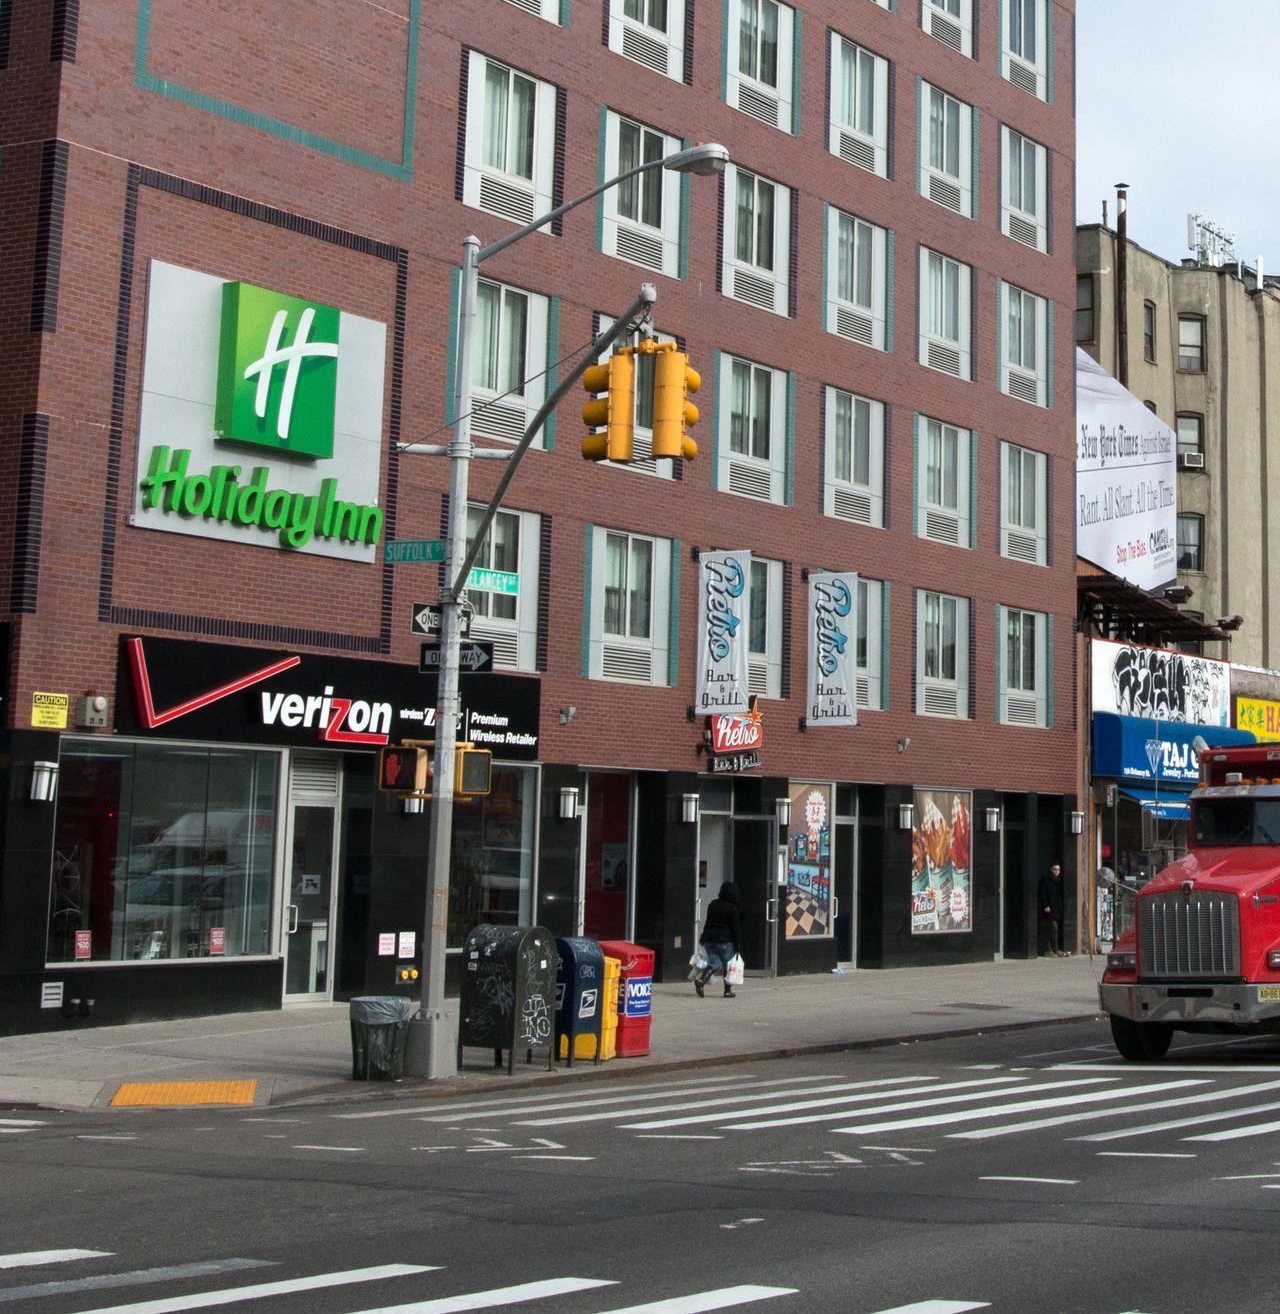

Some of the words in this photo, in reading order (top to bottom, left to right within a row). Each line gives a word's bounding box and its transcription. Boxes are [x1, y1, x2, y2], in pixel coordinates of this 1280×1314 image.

[1081, 424, 1098, 459] New
[1099, 424, 1117, 467] York
[1118, 424, 1138, 458] Times
[140, 444, 320, 548] Holiday
[315, 477, 383, 545] Inn
[1102, 486, 1114, 522] All
[1135, 481, 1146, 515] All
[1147, 480, 1158, 512] the
[386, 542, 433, 561] SUFFOLK
[468, 569, 508, 592] ELANCEY
[705, 556, 746, 663] Retro
[421, 612, 438, 627] ONE
[814, 578, 852, 678] Retro
[461, 650, 482, 664] WAY
[706, 669, 738, 683] Bar
[816, 683, 847, 696] Bar
[35, 695, 67, 706] CAUTION
[261, 685, 393, 745] verizon
[399, 708, 424, 720] wireless
[470, 711, 509, 727] Premium
[469, 729, 506, 743] Wireless
[505, 731, 538, 746] Retailer
[717, 713, 760, 748] Retro
[1161, 740, 1189, 768] TAJ
[627, 982, 652, 997] VOICE
